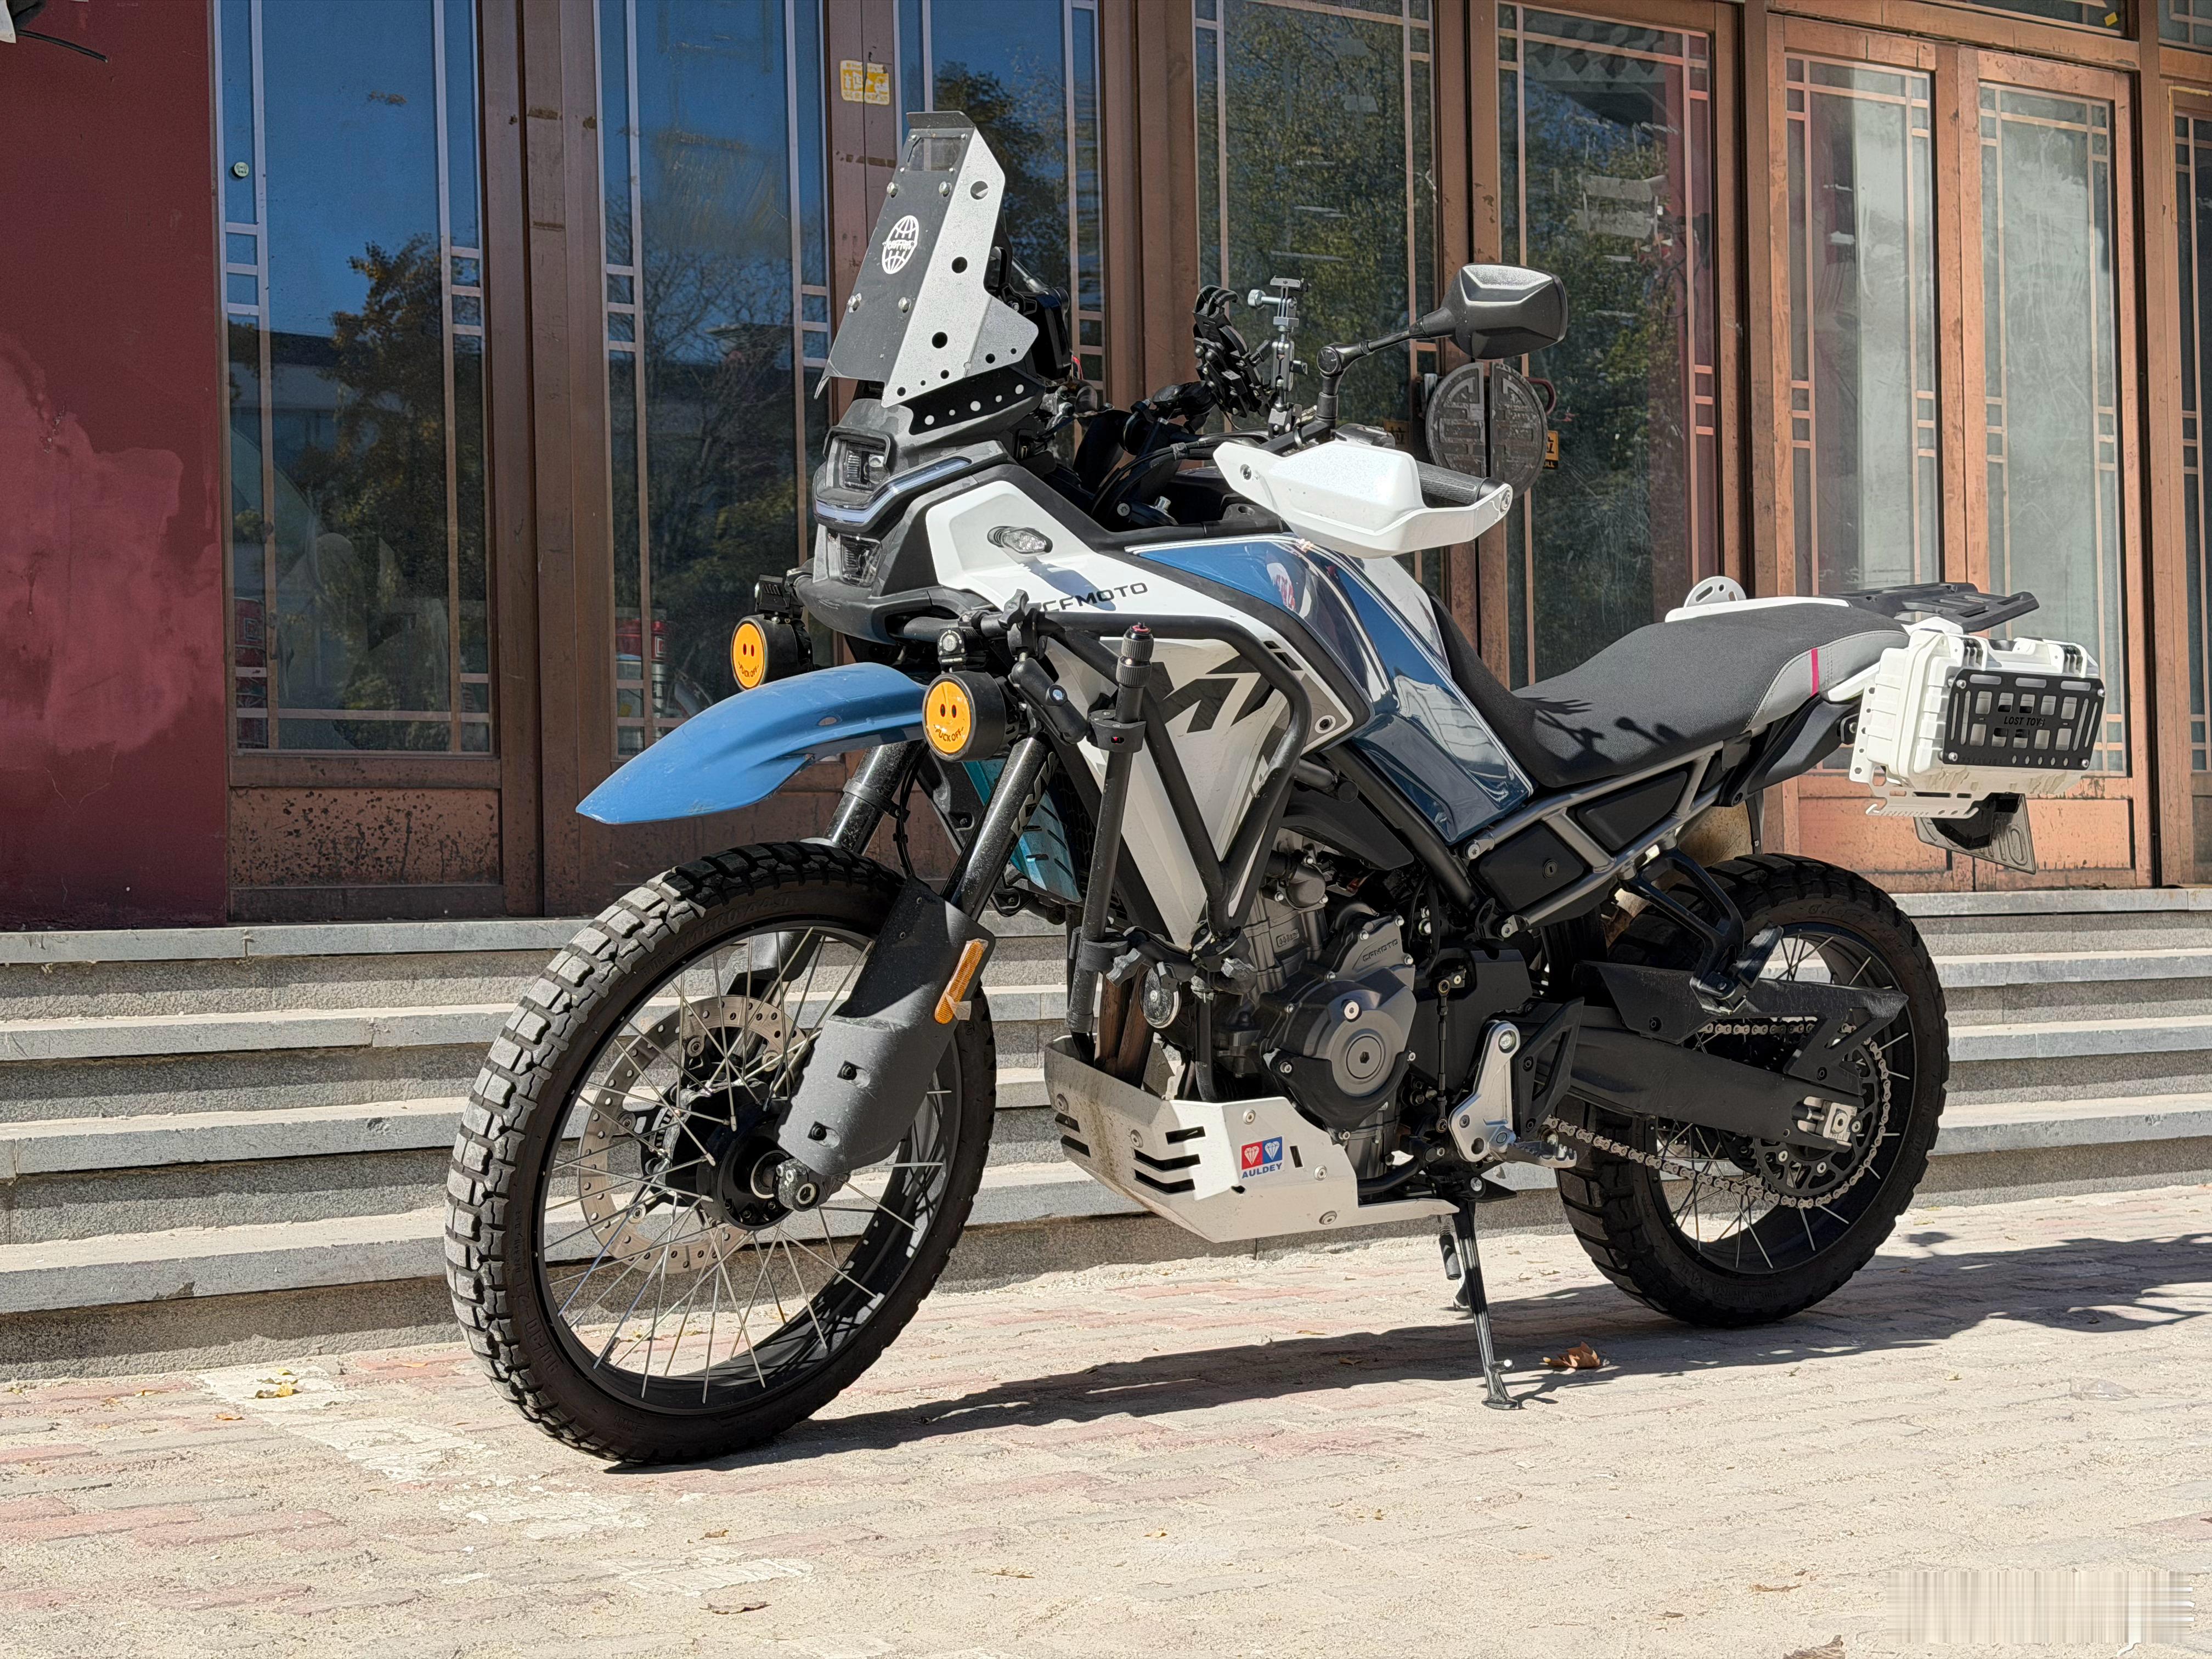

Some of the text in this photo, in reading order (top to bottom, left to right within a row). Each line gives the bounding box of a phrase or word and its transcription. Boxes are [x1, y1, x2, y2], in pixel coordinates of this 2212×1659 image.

[1042, 582, 1148, 612] CFMOTO
[739, 664, 750, 678] FUCK
[2004, 716, 2046, 726] LOST TOYS
[935, 728, 962, 742] FUCK OFF
[1362, 939, 1398, 962] CFMOTO
[1241, 1162, 1283, 1179] AULDEY
